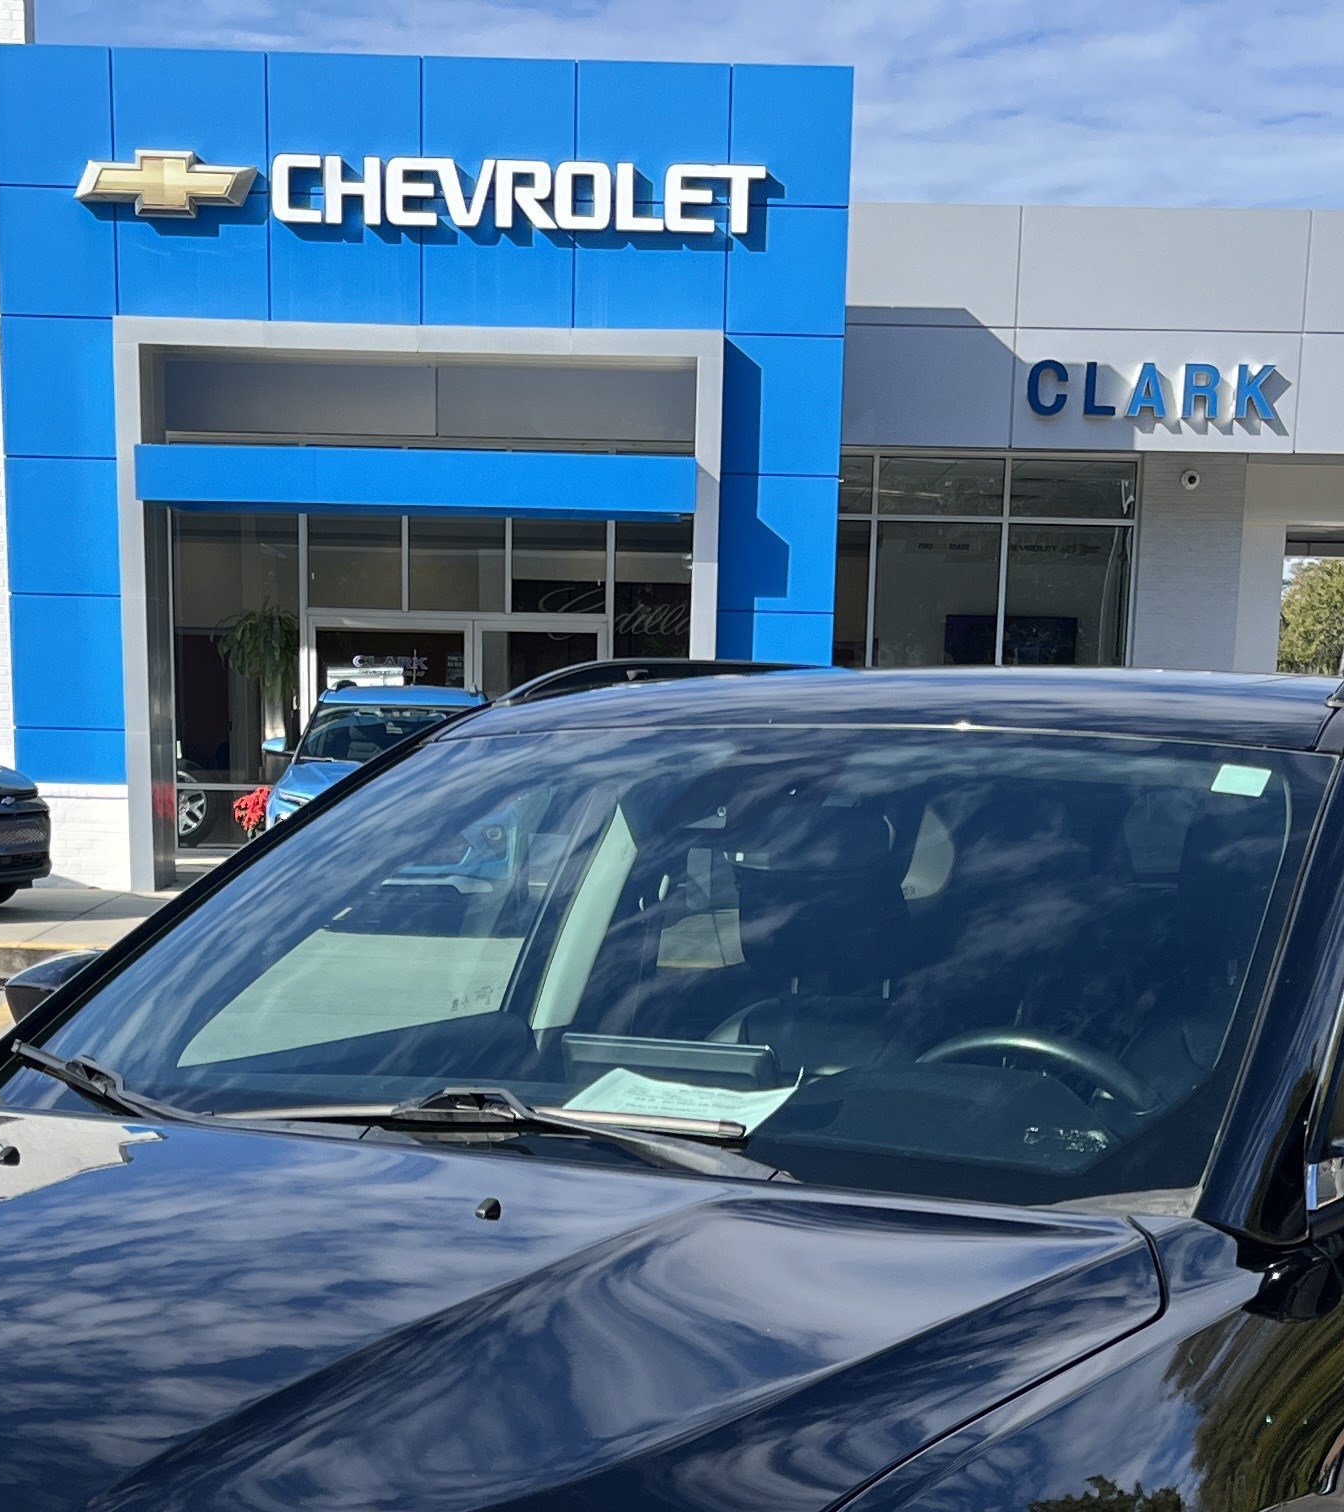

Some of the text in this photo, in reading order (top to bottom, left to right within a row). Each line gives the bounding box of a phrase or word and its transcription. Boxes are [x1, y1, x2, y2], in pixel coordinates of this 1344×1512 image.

[270, 153, 767, 235] CHEVROLET
[1026, 358, 1277, 420] CLARK
[352, 654, 429, 670] CLARK
